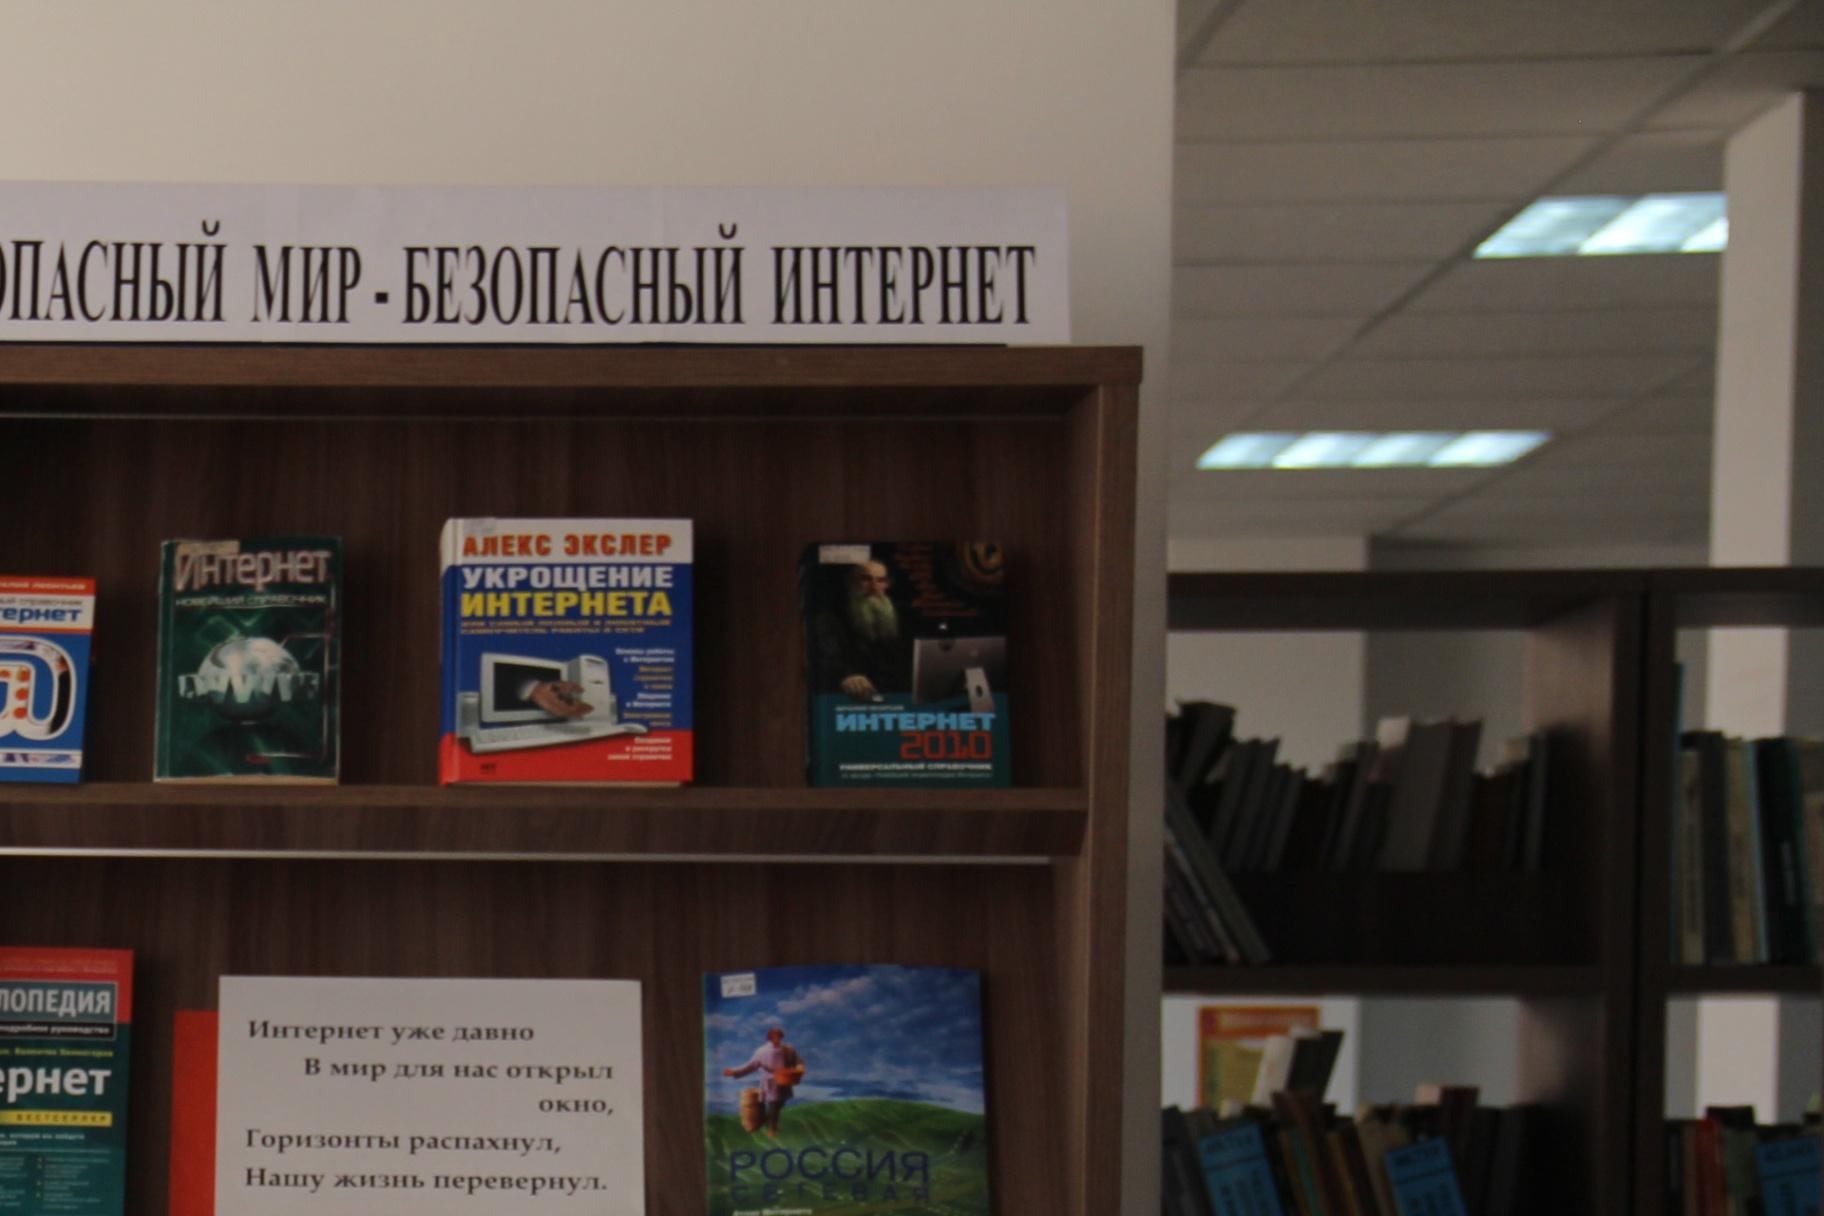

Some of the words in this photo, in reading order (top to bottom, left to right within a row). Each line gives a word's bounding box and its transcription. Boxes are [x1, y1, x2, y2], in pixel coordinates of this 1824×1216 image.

[251, 245, 361, 323] МИР
[402, 222, 745, 324] БЕЗОПАСНЫЙ
[769, 246, 1035, 325] ИНТЕРНЕТ
[463, 534, 552, 557] АЛЕКС
[564, 534, 672, 557] ЭКСЛЕР
[174, 549, 332, 592] Интернет
[462, 566, 674, 591] УКРОЩЕНИЕ
[460, 591, 673, 617] ИНТЕРНЕТА
[835, 711, 996, 732] ИНТЕРНЕТ
[249, 1020, 383, 1044] Интернет
[391, 1023, 443, 1042] уже
[452, 1024, 534, 1042] давно
[304, 1057, 321, 1076] В
[329, 1060, 386, 1082] мир
[393, 1061, 445, 1079] для
[454, 1062, 498, 1079] нас
[506, 1062, 614, 1084] открыл
[538, 1098, 614, 1115] окно,
[246, 1129, 401, 1153] Горизонты
[409, 1133, 561, 1156] распахнул,
[730, 1147, 928, 1183] РОССИЯ
[246, 1168, 325, 1193] Нашу
[333, 1171, 425, 1189] жизнь
[433, 1172, 607, 1195] перевернул.
